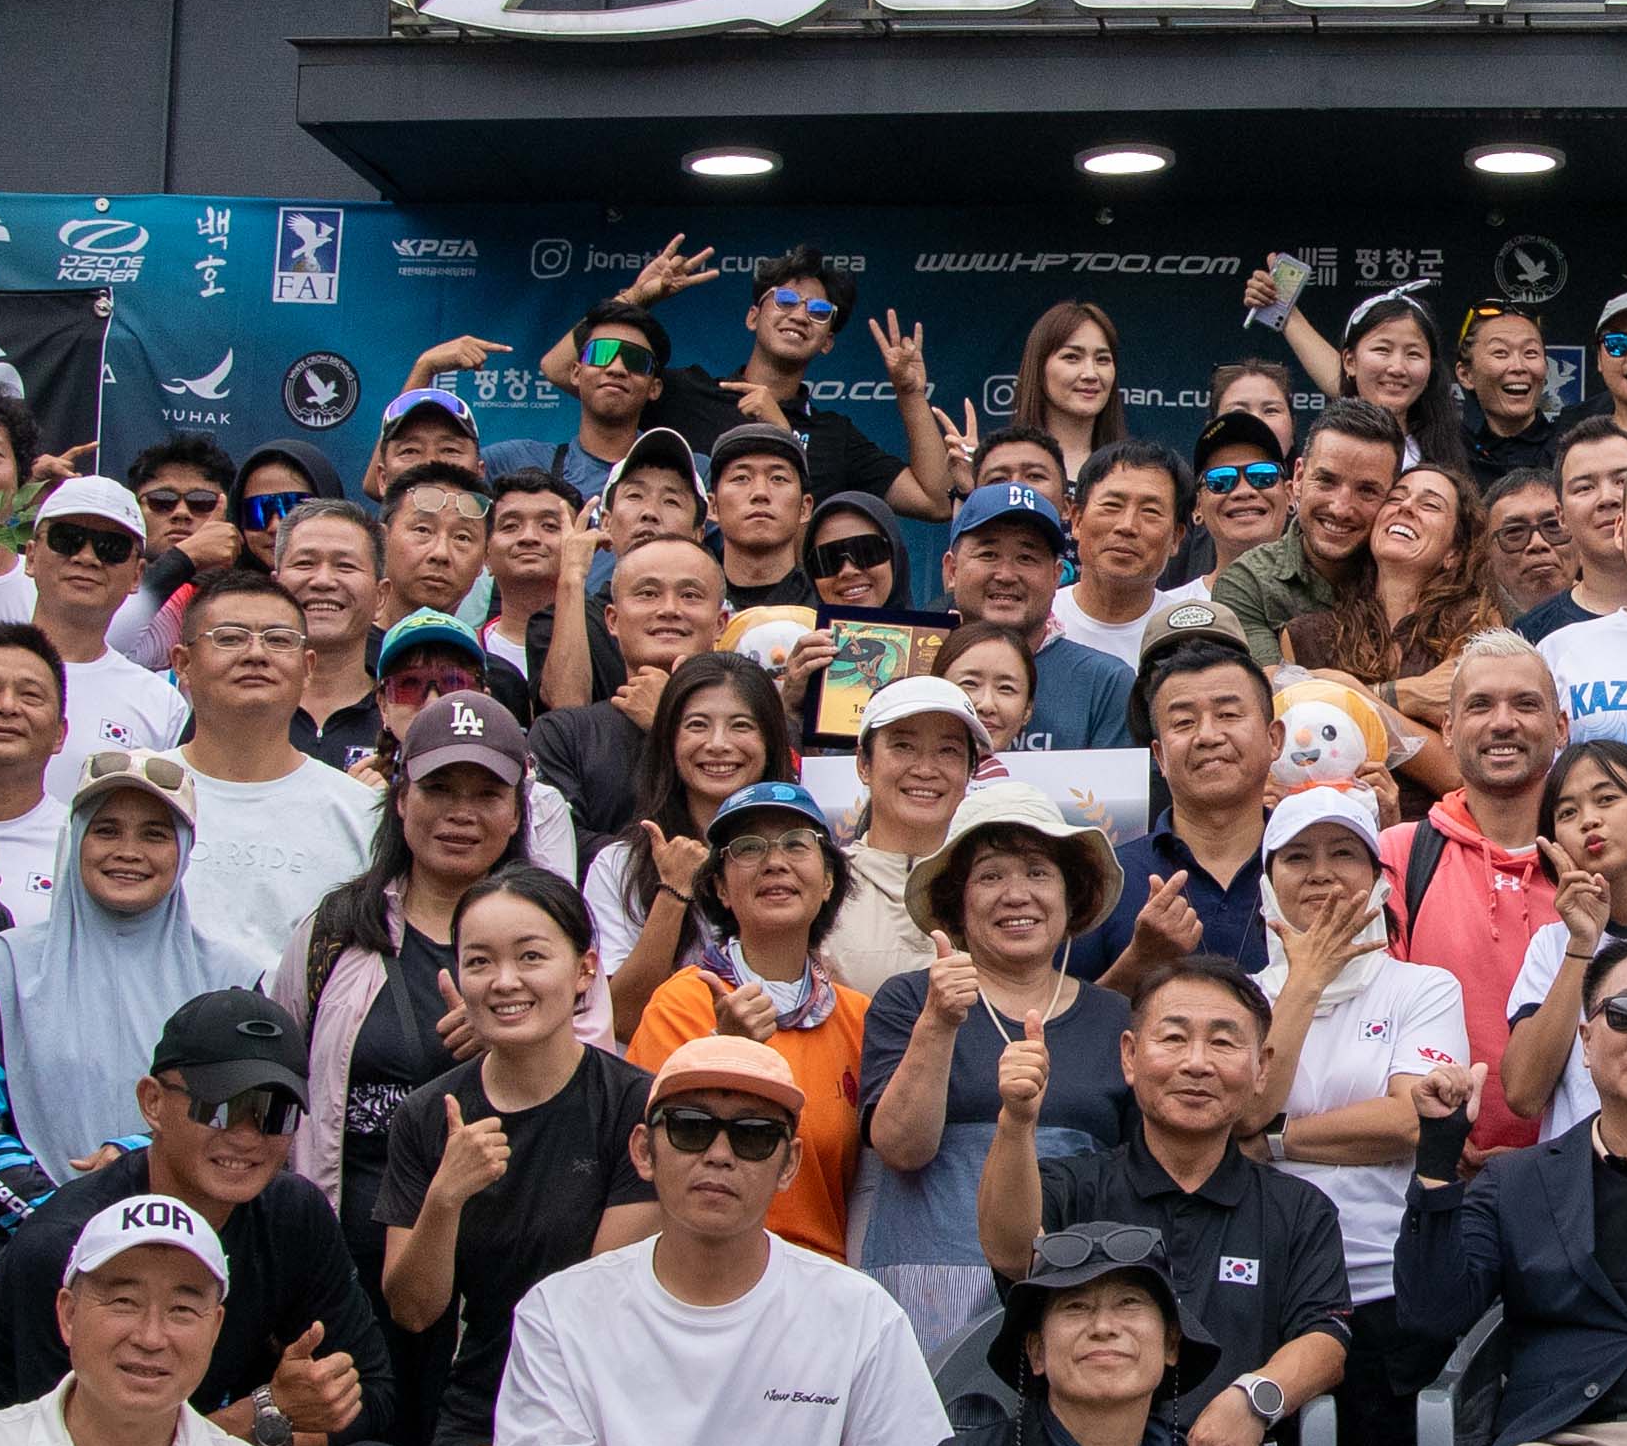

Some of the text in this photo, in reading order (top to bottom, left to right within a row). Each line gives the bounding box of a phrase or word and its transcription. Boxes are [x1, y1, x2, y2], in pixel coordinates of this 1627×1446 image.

[392, 238, 478, 257] KPGA
[60, 255, 145, 269] OZONE
[1355, 248, 1444, 280] 평창군
[57, 268, 140, 283] KOREA
[278, 276, 337, 301] FAI
[161, 408, 231, 425] YUHAK
[450, 701, 484, 736] LA
[763, 1389, 840, 1405] New Balance
